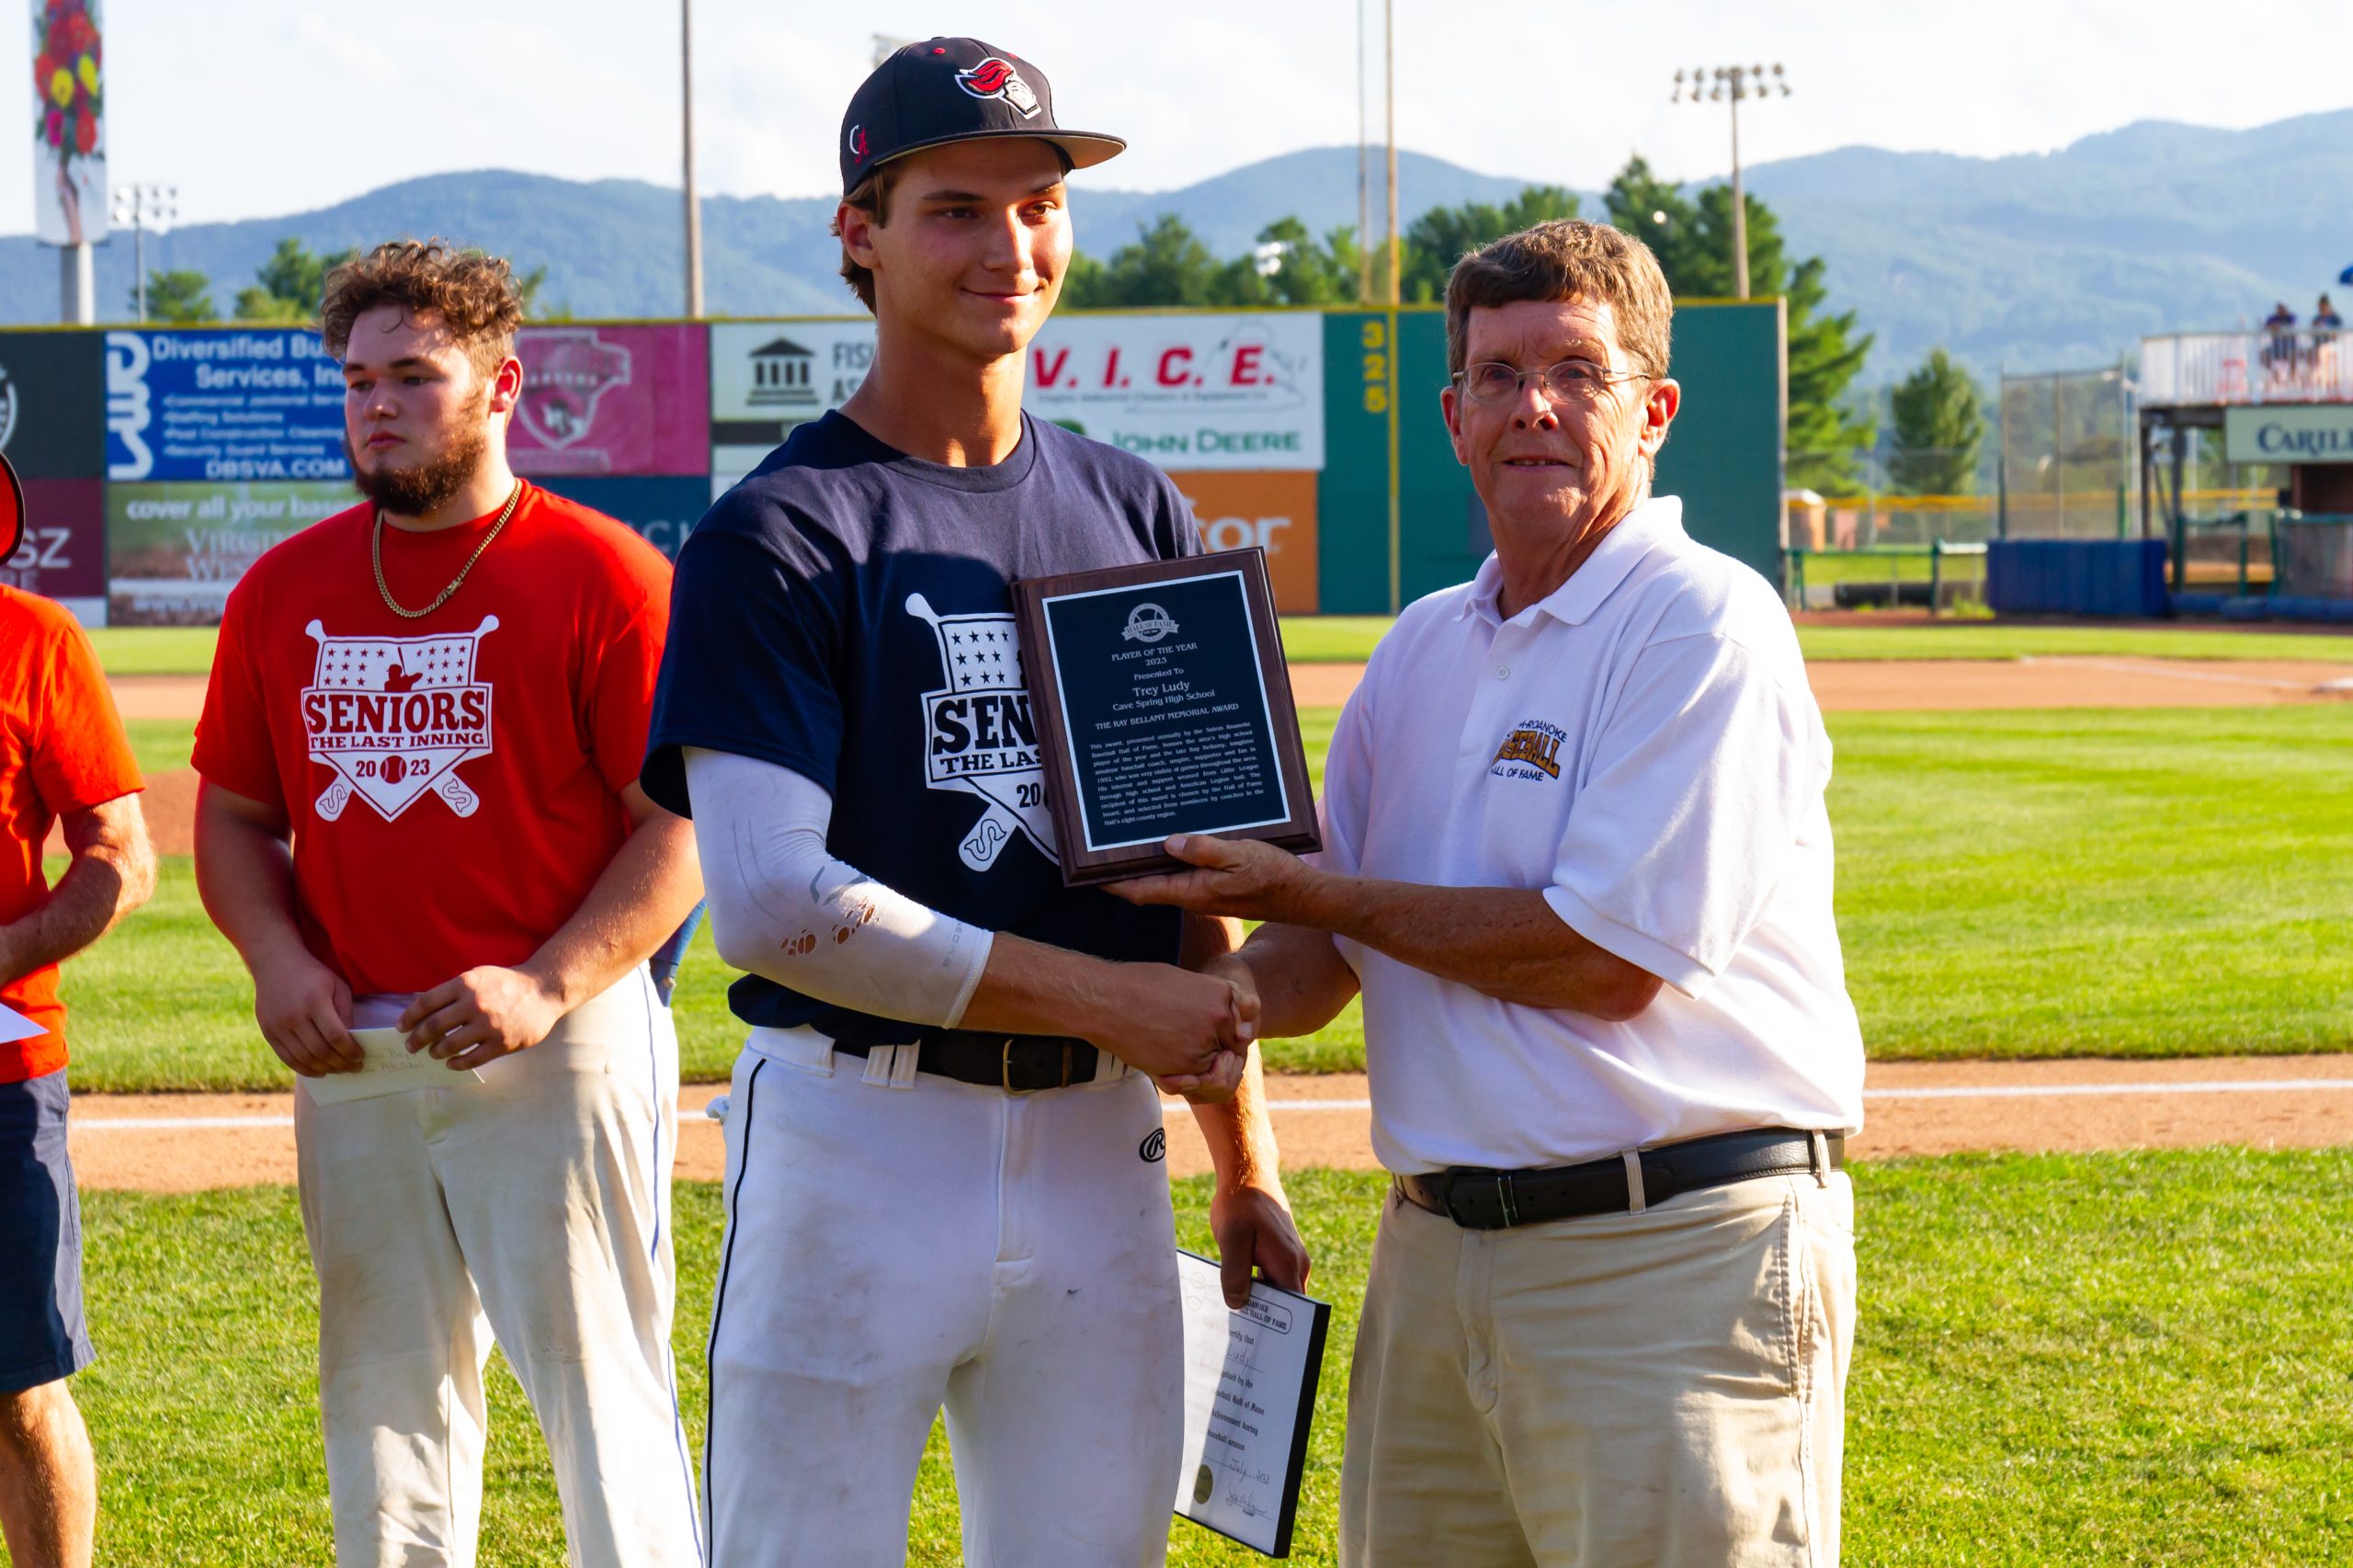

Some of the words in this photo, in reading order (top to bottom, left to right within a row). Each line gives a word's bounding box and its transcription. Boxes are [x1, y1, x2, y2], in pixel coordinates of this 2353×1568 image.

[153, 335, 284, 361] Diversified
[196, 365, 309, 389] Services,
[1197, 429, 1302, 453] DEERE
[205, 460, 345, 478] DBSVA.COM
[127, 498, 192, 520] cover
[197, 497, 225, 519] all
[231, 498, 284, 526] your
[1111, 651, 1142, 661] PLAYER
[1157, 646, 1174, 654] THE
[1176, 642, 1198, 652] YEAR
[1145, 657, 1167, 666] 2023
[1133, 670, 1172, 681] Presented
[1132, 687, 1159, 698] Trey
[1162, 681, 1190, 693] Ludy
[1112, 702, 1134, 711] Cave
[1135, 698, 1164, 709] Spring
[1165, 694, 1184, 704] High
[1186, 689, 1215, 700] School
[304, 690, 485, 734] SENIORS
[1096, 722, 1111, 731] THE
[1113, 720, 1128, 728] RAY
[1131, 713, 1165, 725] BELLAMY
[1168, 708, 1210, 720] MEMORIAL
[1211, 703, 1239, 713] AWARD
[310, 736, 347, 749] THE
[351, 736, 404, 748] LAST
[410, 733, 484, 747] INNING
[356, 760, 376, 778] 20
[410, 759, 430, 777] 23
[940, 754, 995, 774] THE
[1507, 768, 1518, 778] OF
[1518, 769, 1543, 781] FAME
[1272, 1318, 1287, 1330] FAME
